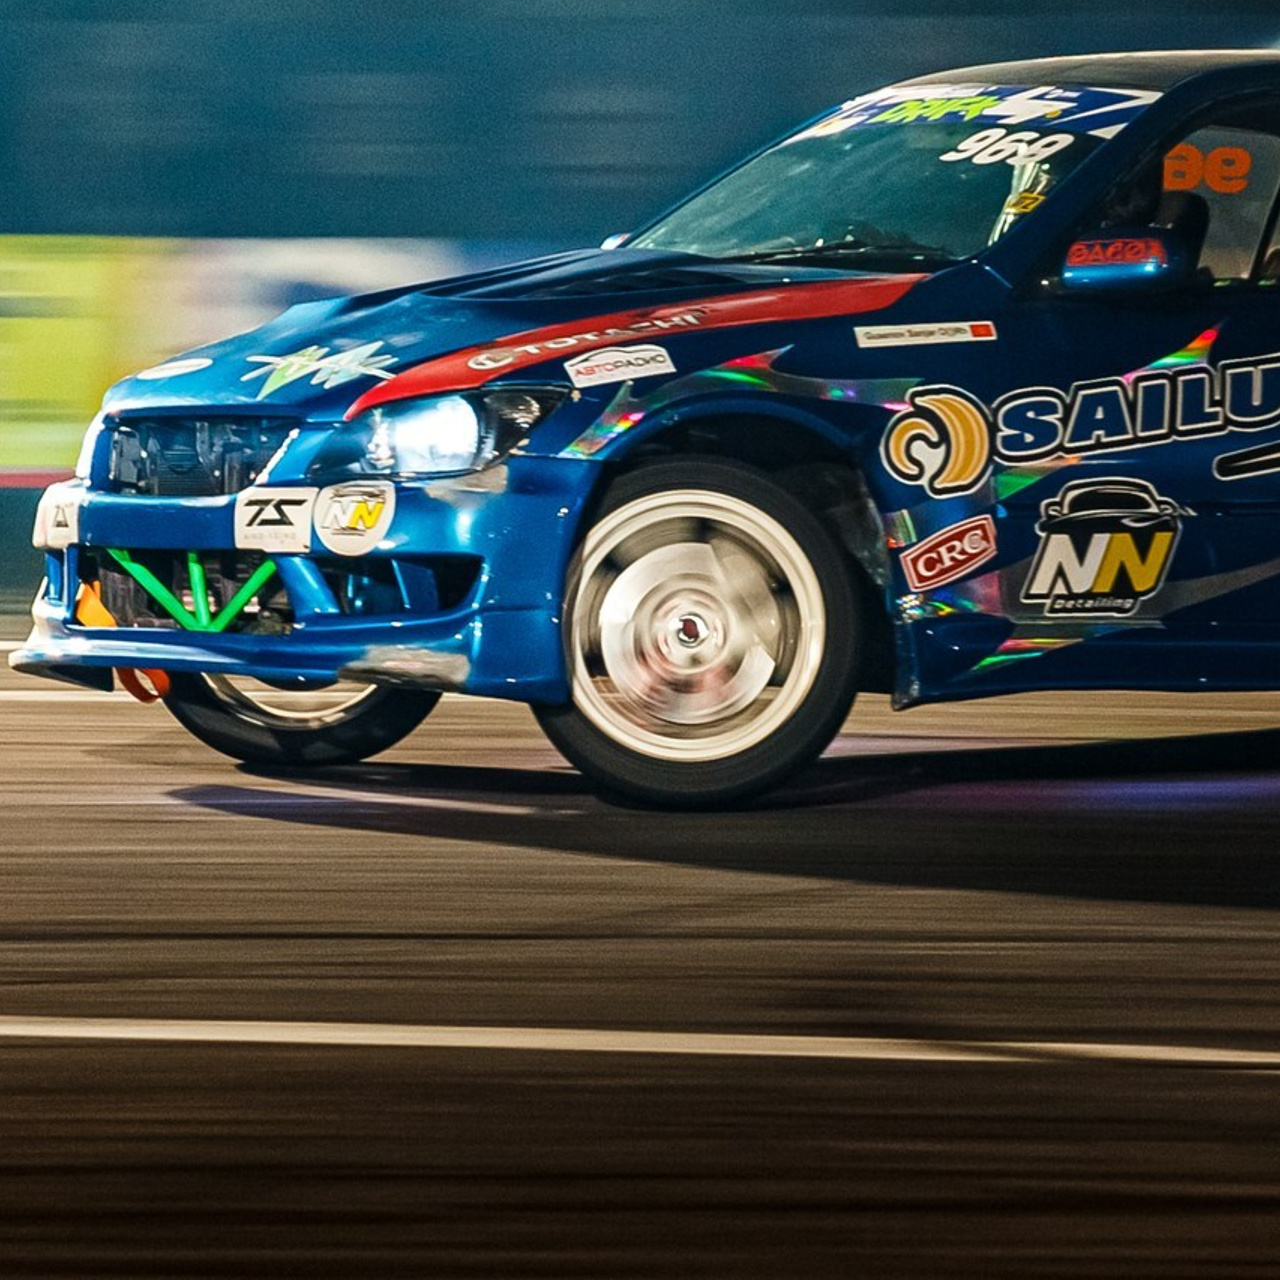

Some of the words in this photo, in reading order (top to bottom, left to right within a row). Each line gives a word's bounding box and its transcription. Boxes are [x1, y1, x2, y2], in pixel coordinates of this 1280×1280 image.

[939, 128, 1075, 166] 969
[322, 501, 386, 529] NN
[916, 529, 989, 577] CRC
[1029, 531, 1174, 594] NN
